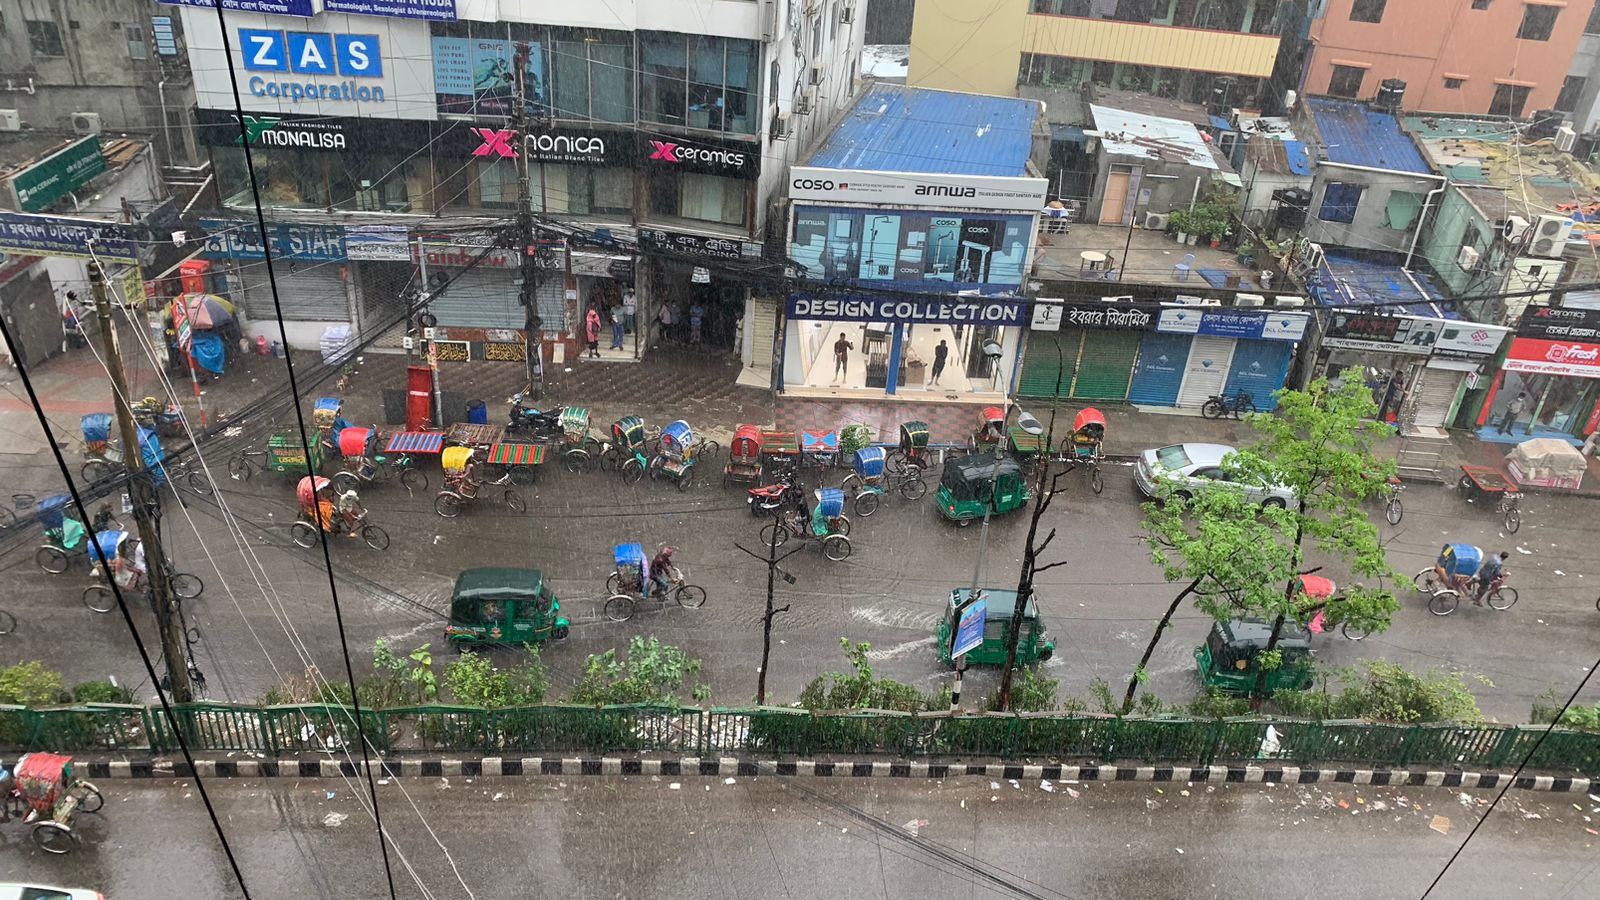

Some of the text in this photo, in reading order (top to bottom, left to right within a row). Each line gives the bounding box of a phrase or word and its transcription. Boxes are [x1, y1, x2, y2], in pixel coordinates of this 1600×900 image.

[249, 75, 384, 102] Corporation
[262, 130, 345, 148] MONALISA
[793, 179, 835, 191] COSO
[915, 185, 976, 198] annwa
[936, 219, 957, 227] COSO
[795, 300, 1019, 321] DESIGN COLLECTION
[1105, 307, 1151, 326] সিরামিক
